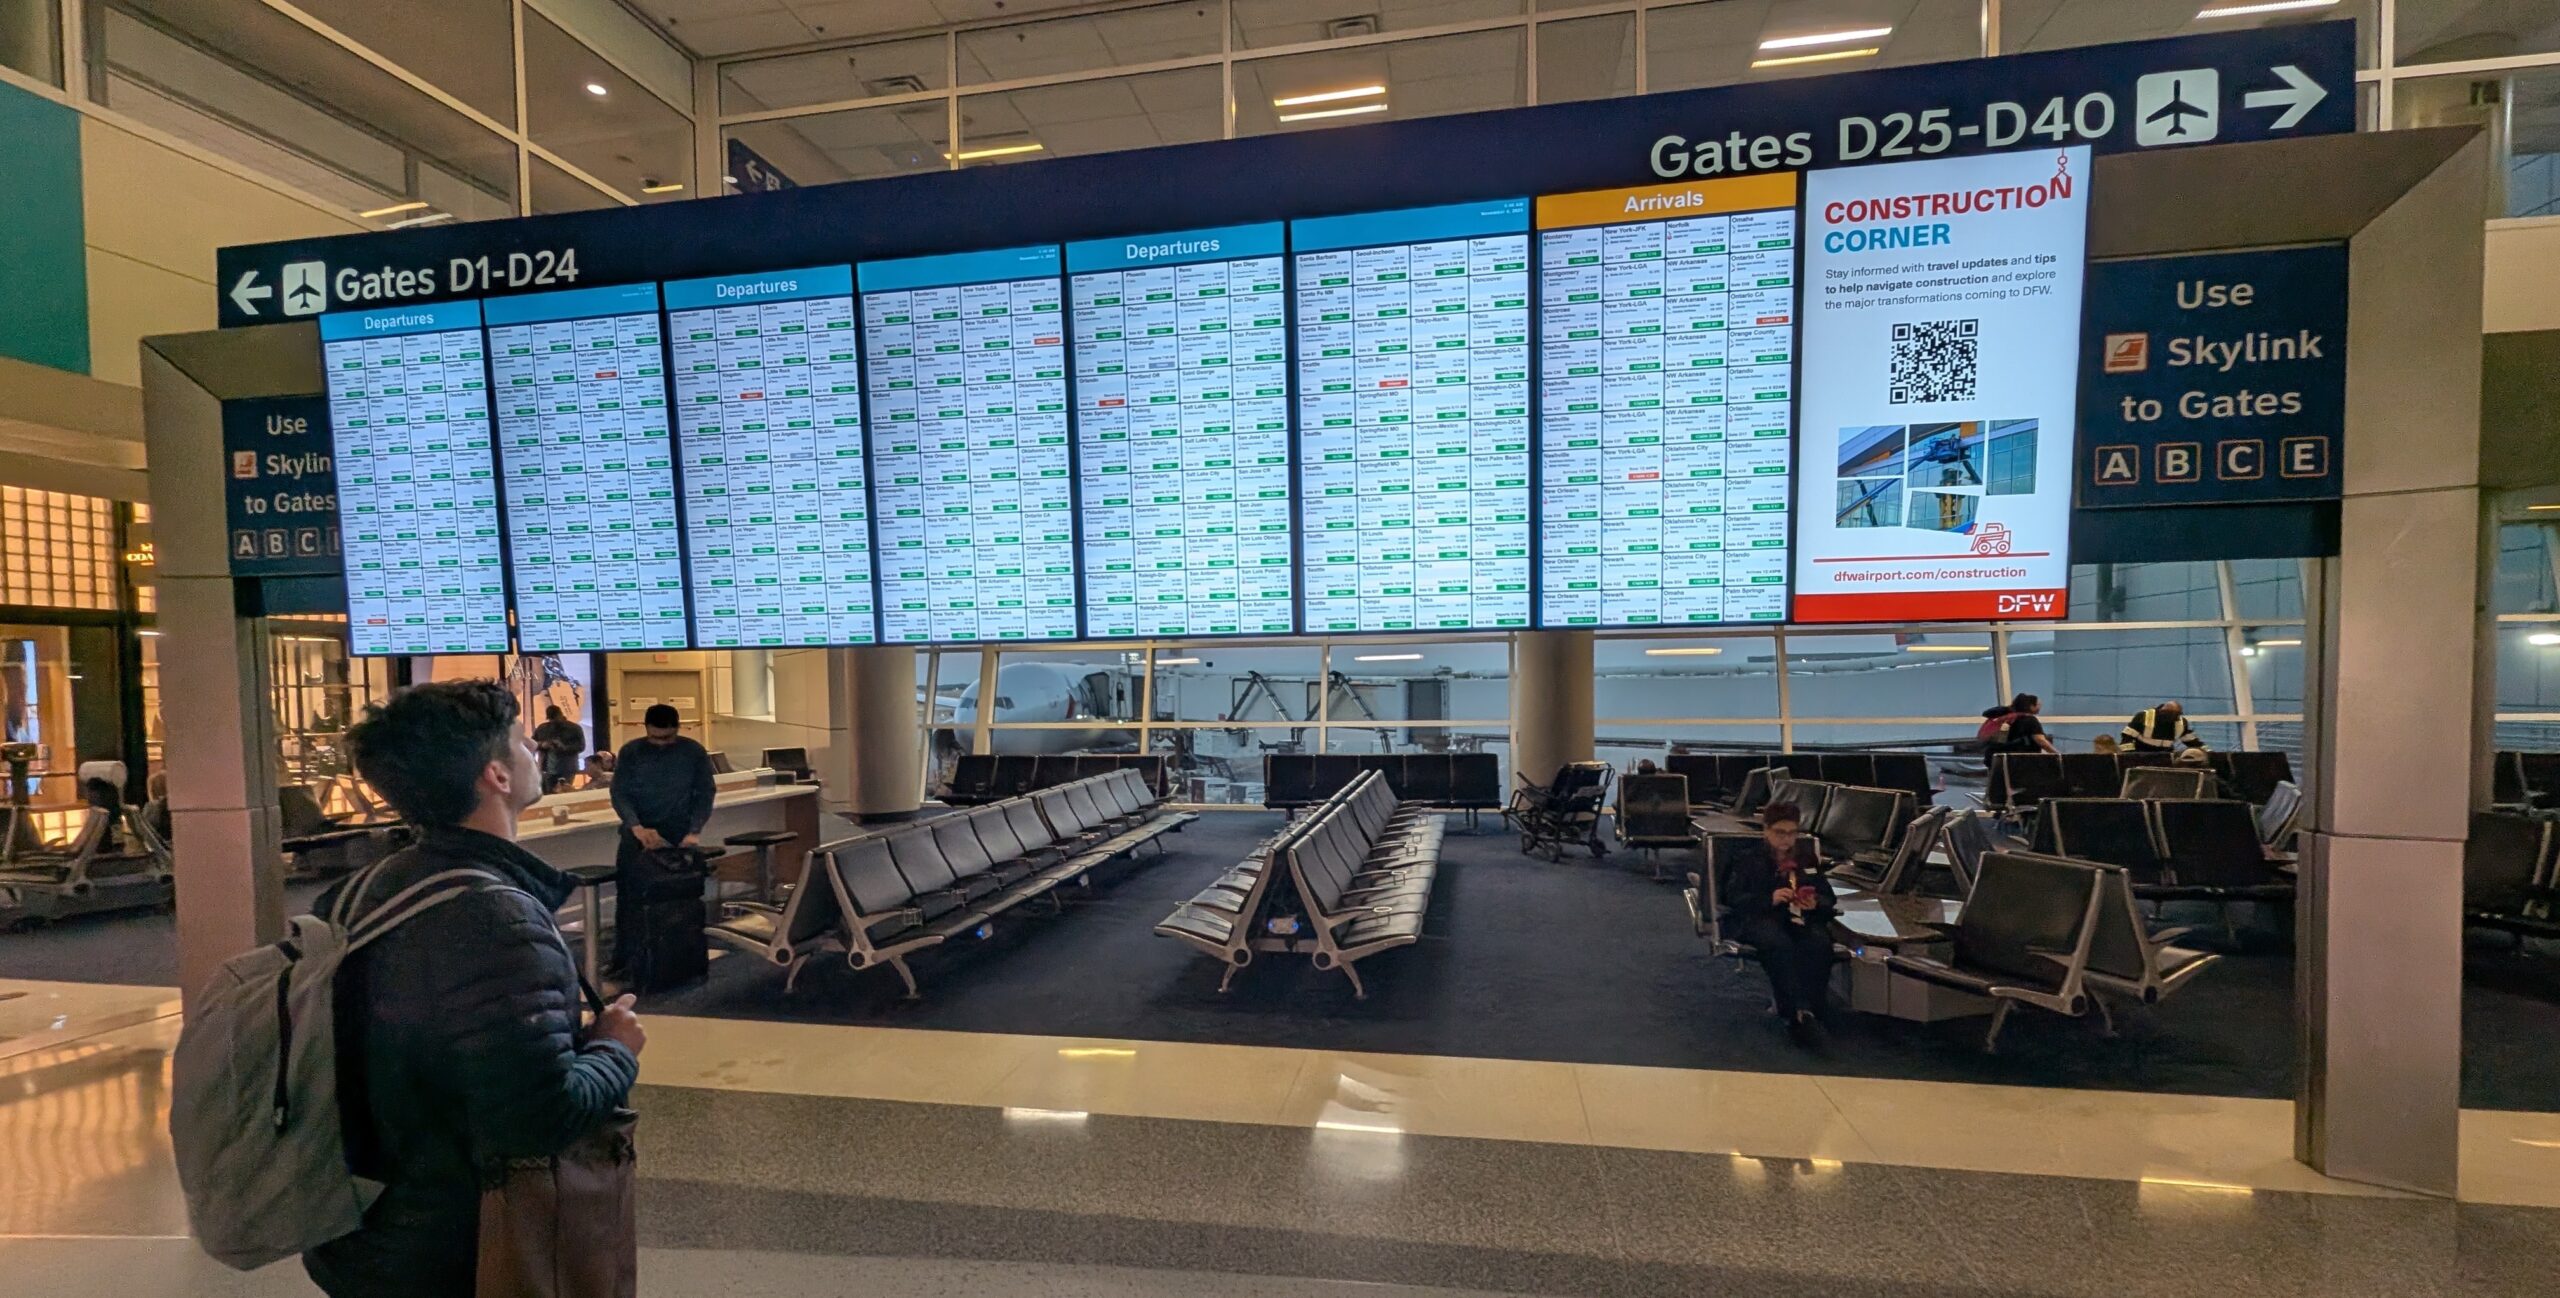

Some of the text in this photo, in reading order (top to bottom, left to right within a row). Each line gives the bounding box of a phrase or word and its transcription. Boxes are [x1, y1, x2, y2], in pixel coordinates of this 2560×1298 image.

[1650, 91, 2116, 179] Gates D25-D40
[1624, 190, 1705, 214] Arrivals
[1824, 175, 2073, 224] CONSTRUCTION
[1731, 215, 1754, 223] Omaha
[1667, 220, 1690, 229] Norfolk
[1604, 225, 1646, 235] New York-JFK
[1542, 232, 1573, 242] Monterrey
[1823, 223, 1951, 254] CORNER
[1125, 237, 1221, 261] Departures
[1678, 257, 1708, 266] Arkansas
[1729, 253, 1754, 262] Ontario
[1618, 262, 1647, 271] York-LGA
[1825, 253, 2057, 281] Stay informed with travel updates and tips
[335, 248, 580, 303] Gates D1-D24
[1542, 268, 1580, 279] Montgomery
[1824, 269, 2056, 296] to help navigate construction and explore
[716, 279, 798, 299] Departures
[1678, 295, 1707, 303] Arkansas
[1729, 291, 1754, 300] Ontario
[1824, 284, 2053, 311] the major transformations coming to DFW.
[2176, 278, 2255, 311] Use
[1618, 300, 1647, 308] York-LGA
[1542, 306, 1571, 314] Montrose
[363, 311, 435, 332] Departures
[1677, 332, 1707, 341] Arkansas
[1729, 328, 1776, 339] Orange County
[1617, 337, 1647, 345] York-LGA
[1542, 343, 1570, 351] Nashville
[2167, 328, 2323, 373] Skylink
[1677, 370, 1706, 378] Arkansas
[1728, 367, 1754, 375] Orlando
[1617, 374, 1647, 382] York-LGA
[1542, 379, 1570, 387] Nashville
[1728, 404, 1753, 412] Orlando
[2121, 389, 2302, 423] to Gates
[1617, 411, 1646, 419] York-LGA
[1676, 407, 1706, 415] Arkansas
[1542, 415, 1570, 423] Nashville
[266, 414, 309, 436] Use
[1664, 444, 1709, 452] Oklahoma City
[1727, 441, 1752, 449] Orlando
[1542, 451, 1570, 459] Nashville
[1617, 447, 1646, 455] York-LGA
[266, 452, 331, 477] Skylin
[2101, 441, 2315, 480] A B C E
[1695, 480, 1708, 489] City
[1726, 478, 1752, 486] Orlando
[1556, 486, 1579, 494] Orleans
[244, 493, 336, 515] to Gates
[1663, 517, 1707, 525] Oklahoma City
[238, 534, 255, 555] A
[269, 532, 284, 554] B
[301, 532, 315, 552] C
[1694, 553, 1707, 561] City
[1833, 566, 2027, 583] dfwairport.com/construction
[1741, 587, 1765, 595] Springs
[1997, 593, 2056, 613] DFW
